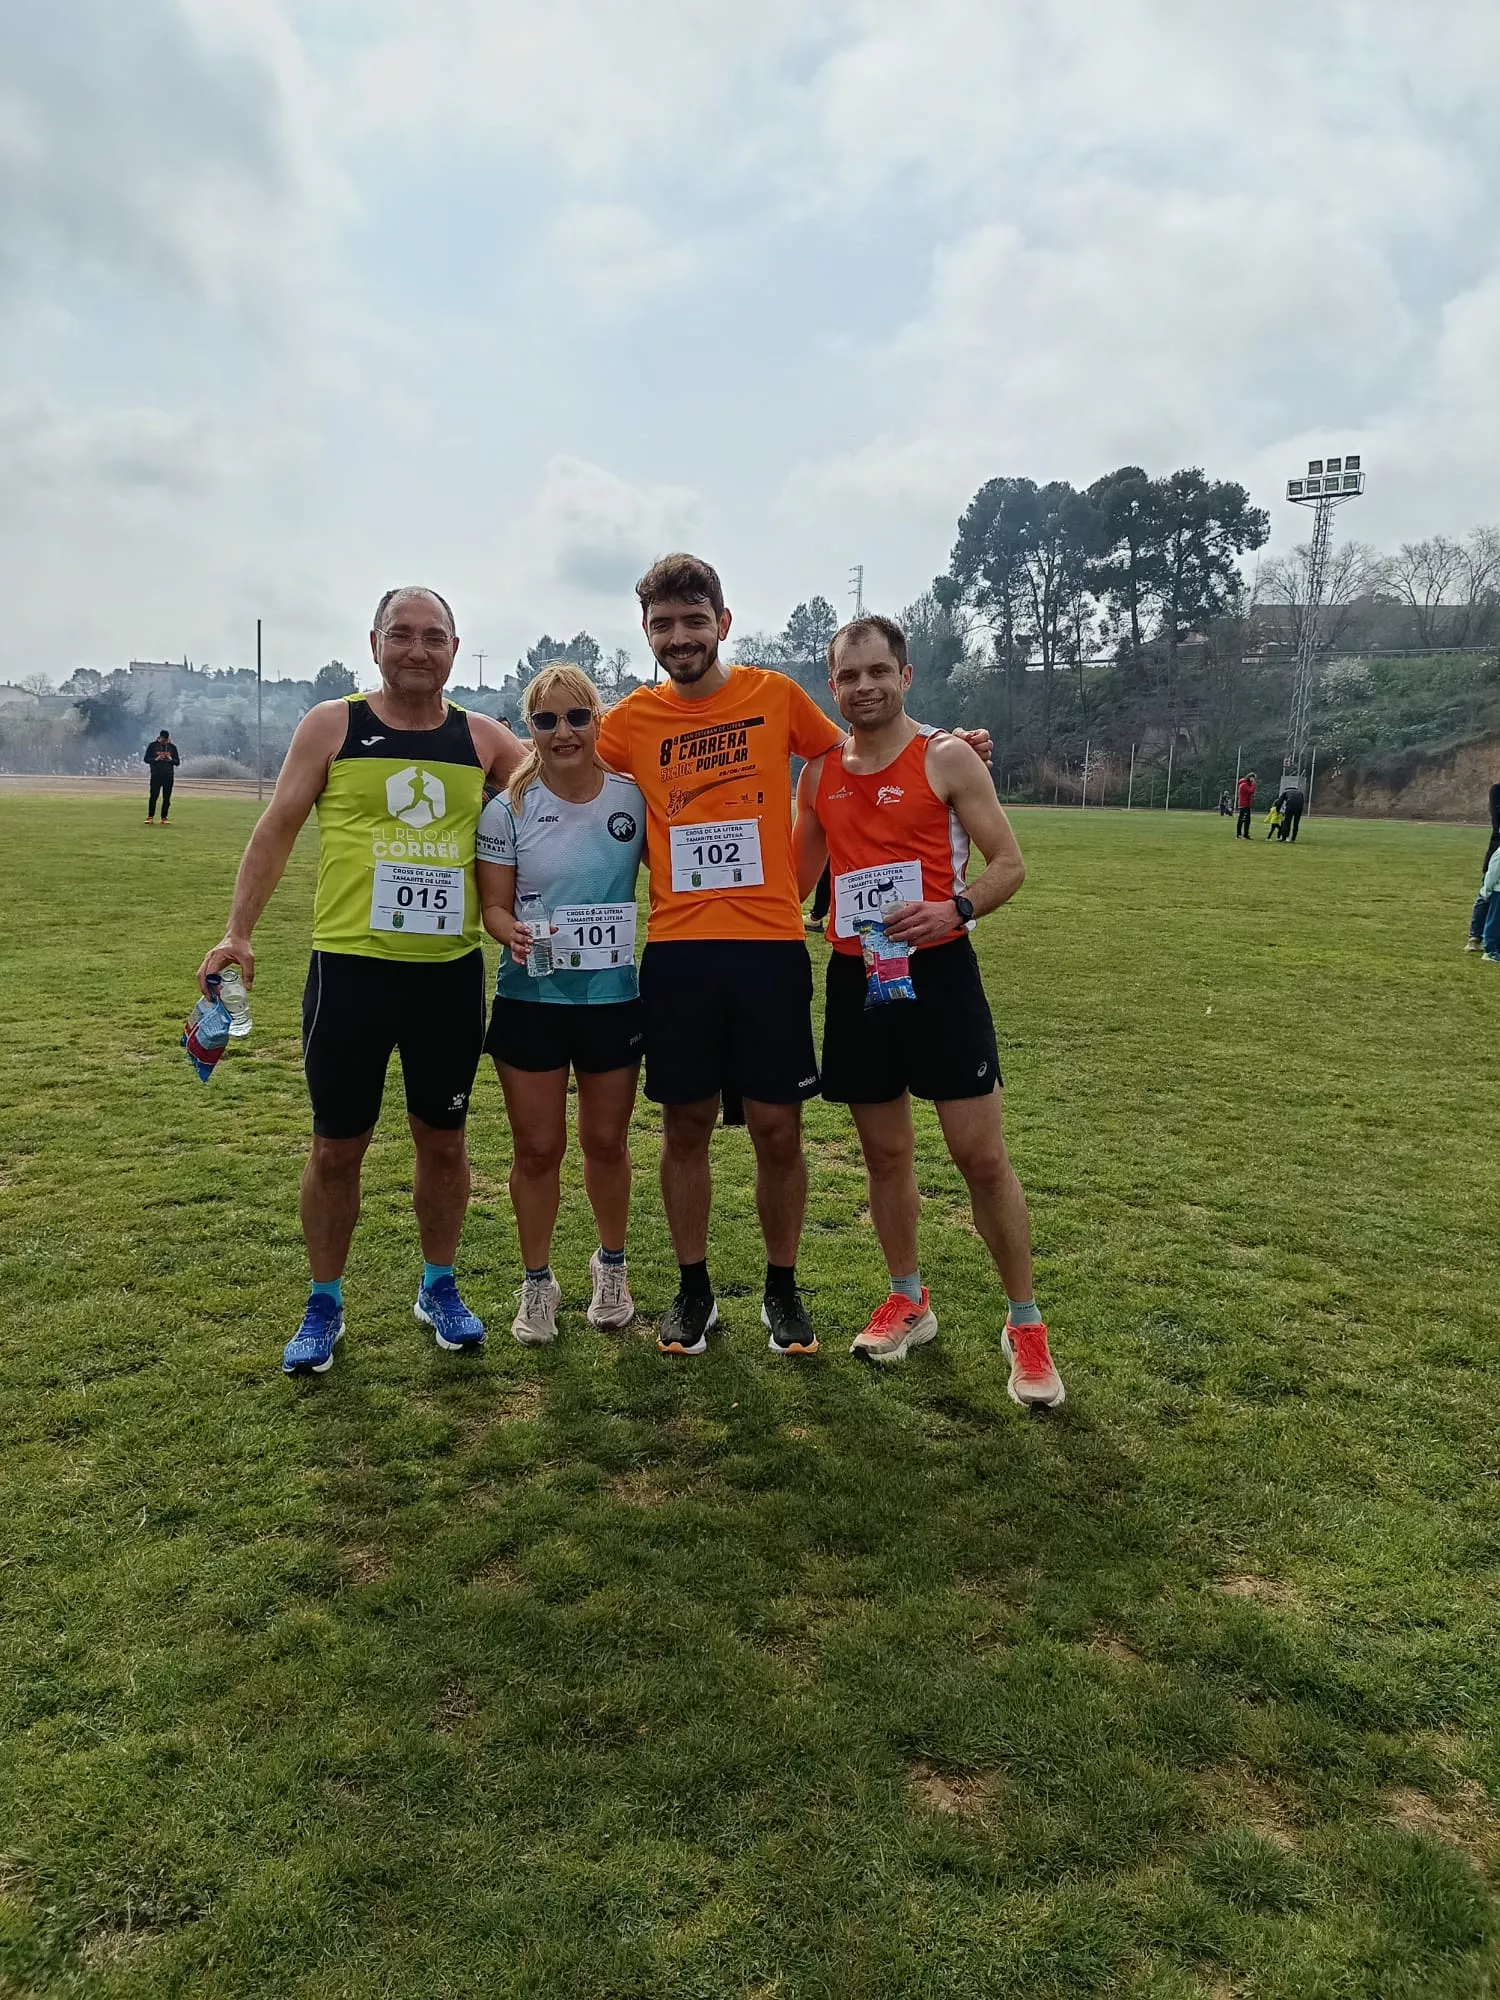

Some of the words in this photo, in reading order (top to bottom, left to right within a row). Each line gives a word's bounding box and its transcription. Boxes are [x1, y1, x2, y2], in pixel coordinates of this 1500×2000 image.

[678, 730, 747, 761] CARRERA
[695, 747, 748, 773] POPULAR
[371, 827, 392, 841] EL
[395, 827, 438, 841] RETO
[441, 829, 459, 843] DE
[371, 840, 460, 858] CORRER
[483, 842, 506, 853] TRAIL
[692, 842, 741, 865] 102
[393, 868, 414, 876] CROSS
[848, 879, 873, 889] TAMARITE
[396, 886, 448, 910] 015
[854, 888, 882, 910] 10
[573, 925, 616, 946] 101
